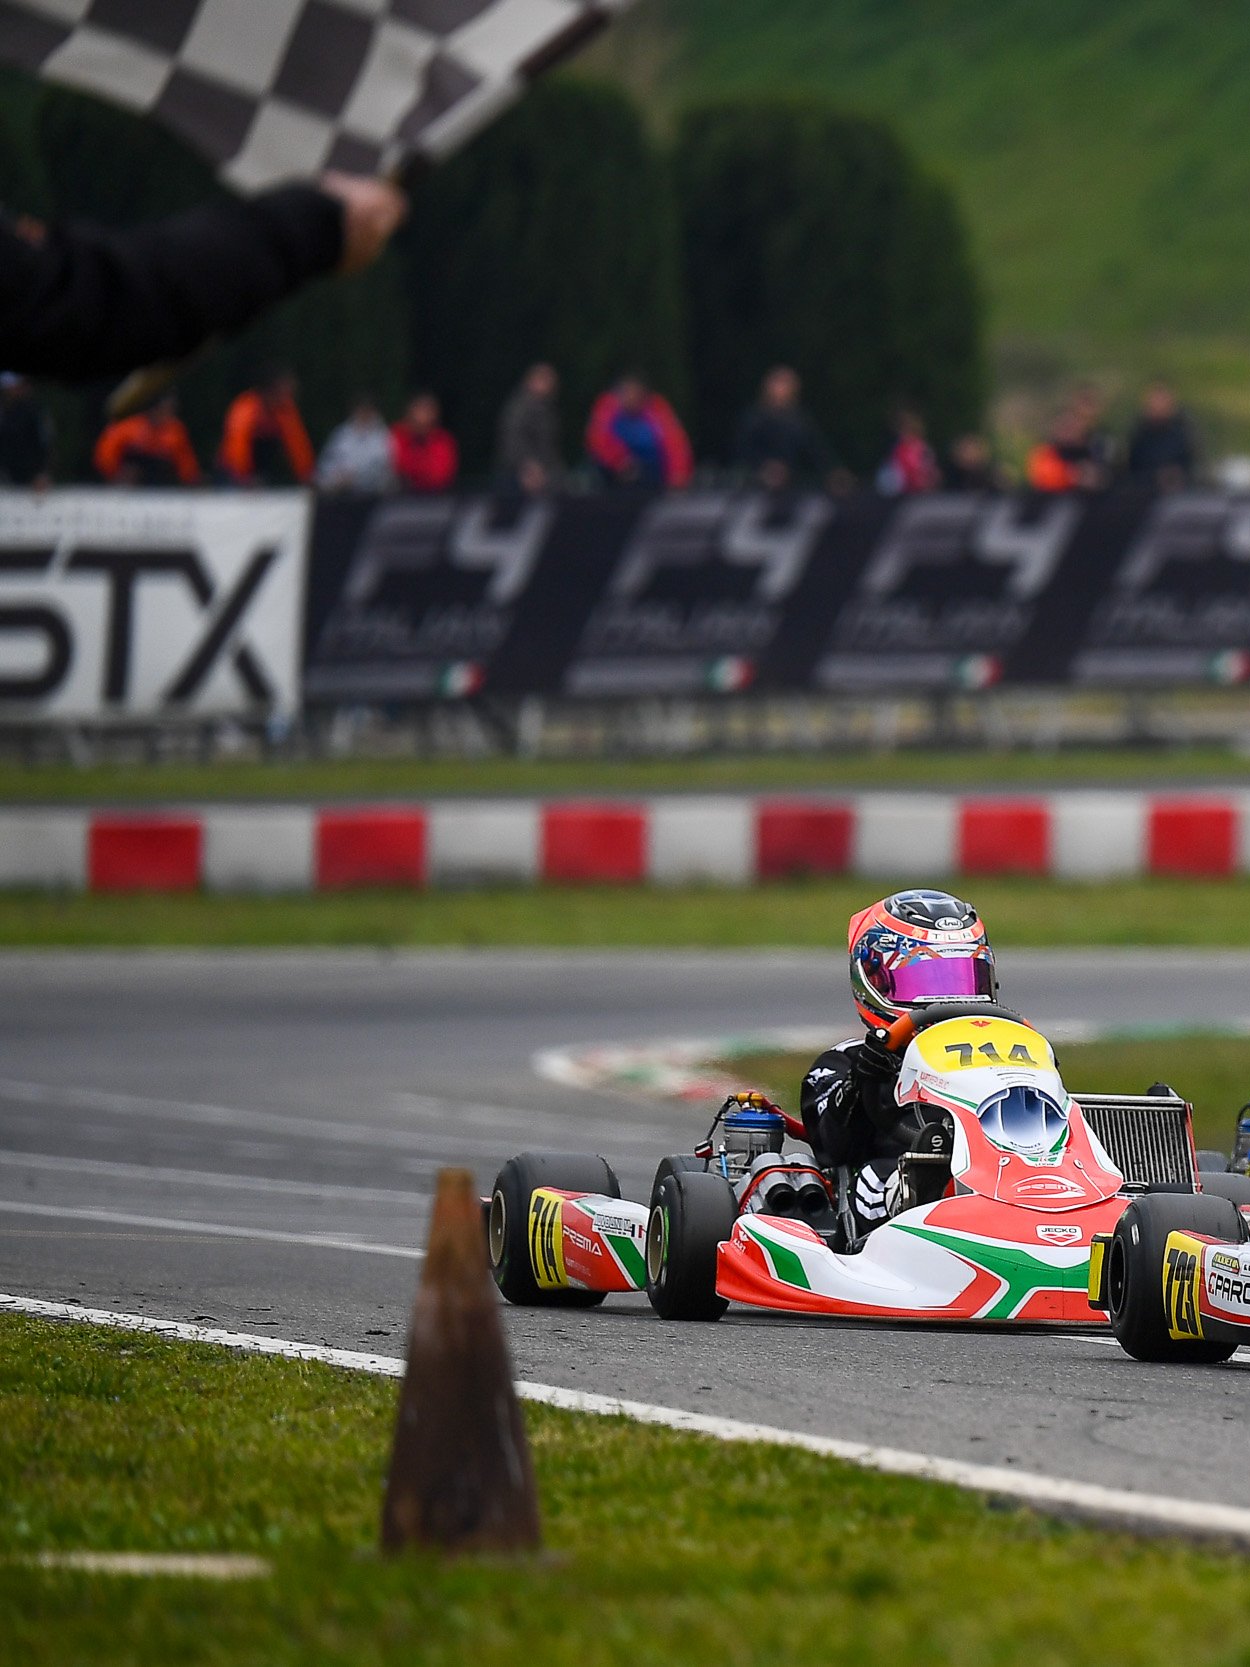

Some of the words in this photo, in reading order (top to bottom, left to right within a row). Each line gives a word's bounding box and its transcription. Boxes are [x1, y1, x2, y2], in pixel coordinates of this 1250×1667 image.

[344, 497, 553, 602] F4
[612, 496, 832, 600] F4
[862, 496, 1080, 598] F4
[944, 1042, 1038, 1067] 714
[531, 1196, 561, 1283] 714
[563, 1224, 603, 1256] PREMA
[1166, 1248, 1199, 1336] 723
